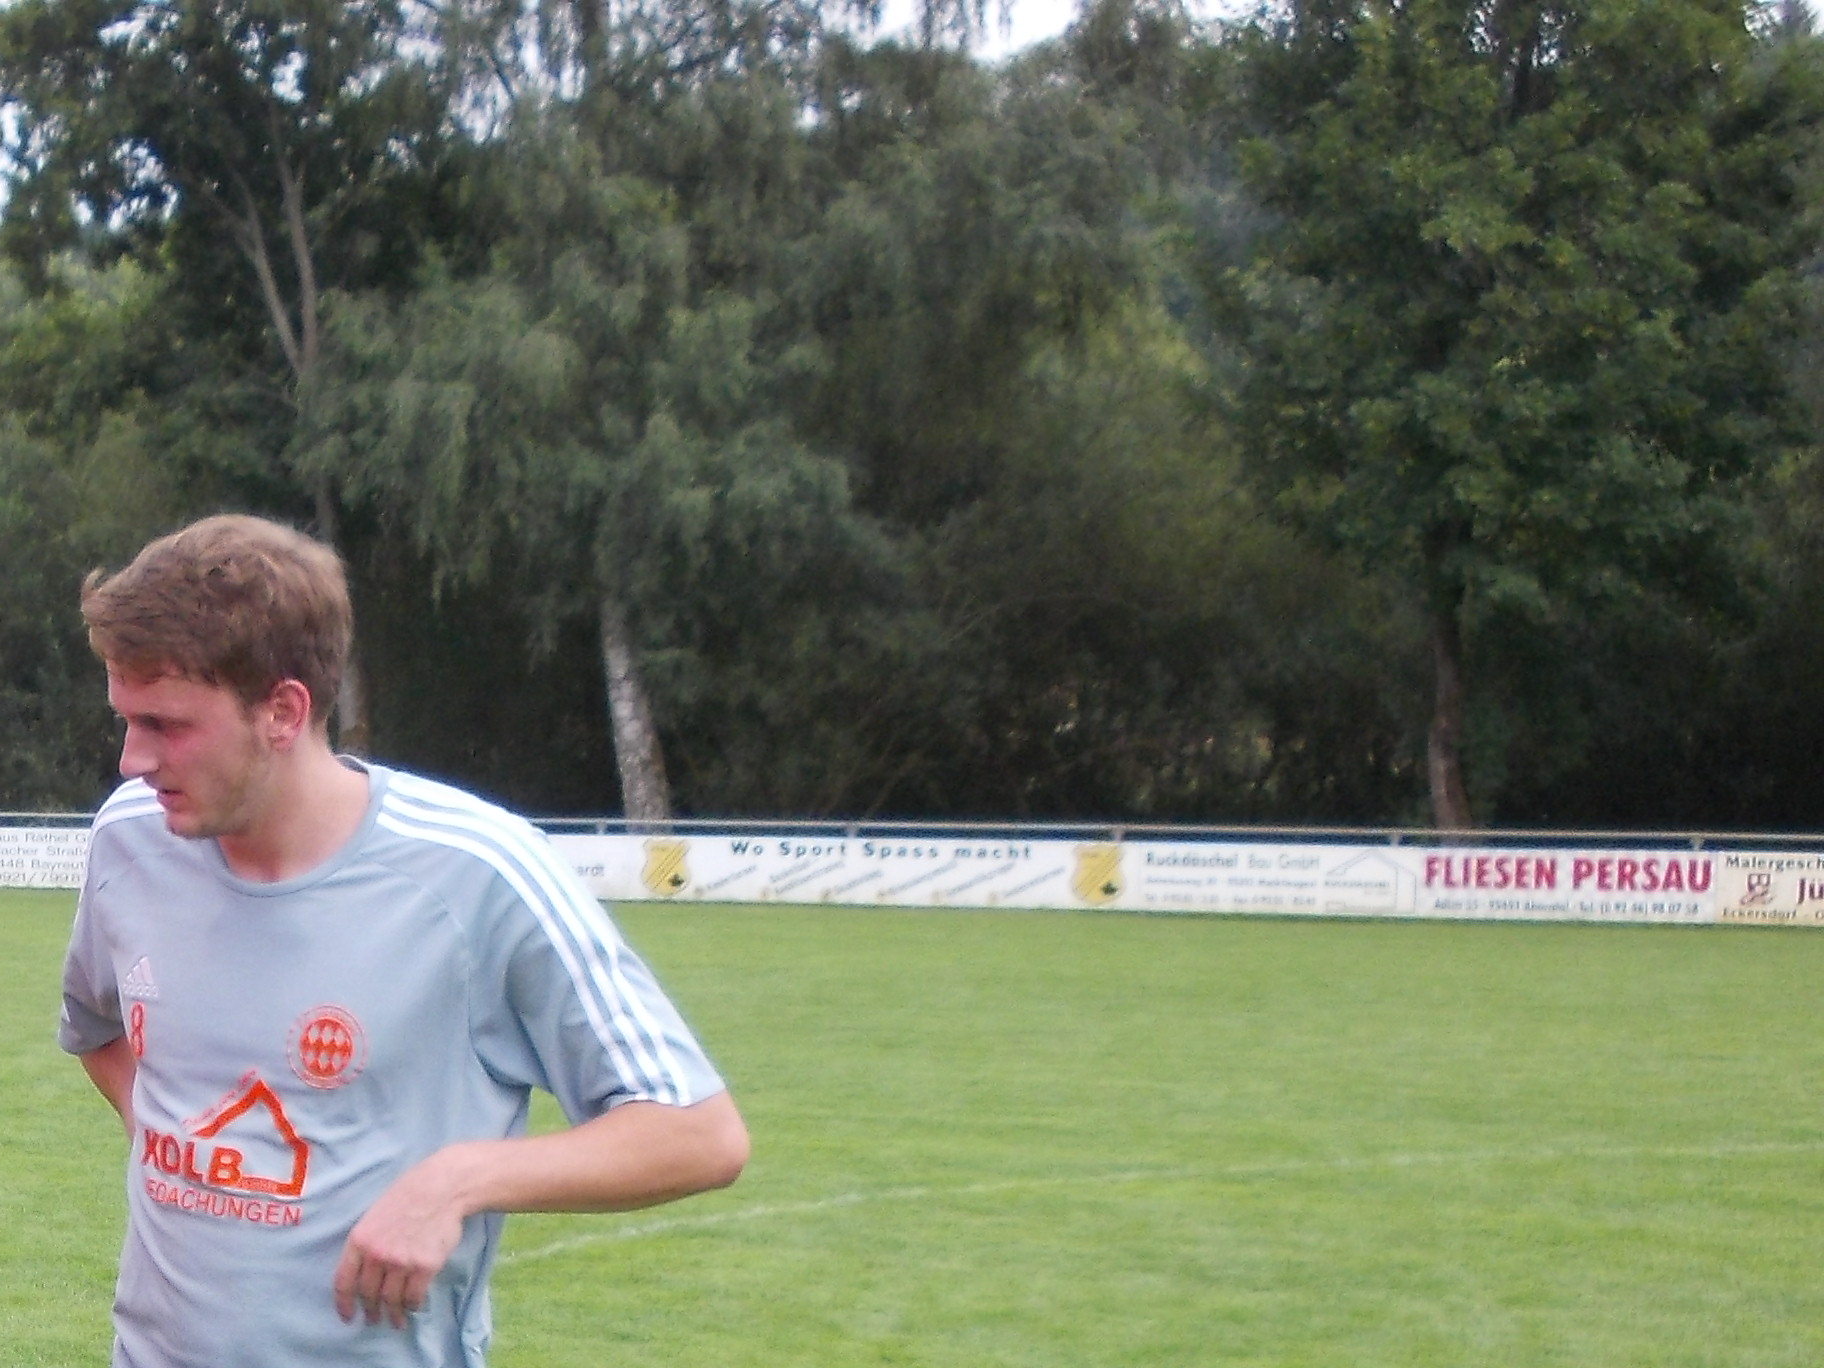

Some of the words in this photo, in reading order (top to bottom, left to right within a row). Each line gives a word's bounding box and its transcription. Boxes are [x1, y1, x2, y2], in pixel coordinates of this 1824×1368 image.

[75, 833, 86, 843] G
[45, 845, 87, 857] Straß
[731, 841, 764, 856] Wo
[780, 842, 847, 858] Sport
[864, 842, 938, 859] Spass
[955, 844, 1031, 859] macht
[30, 859, 84, 871] Bayreut
[1278, 854, 1320, 869] GmbH
[1726, 856, 1824, 872] Malergesch
[1424, 856, 1558, 889] FLIESEN
[1572, 858, 1712, 893] PERSAU
[1797, 878, 1824, 905] Jü
[131, 1002, 145, 1058] 8
